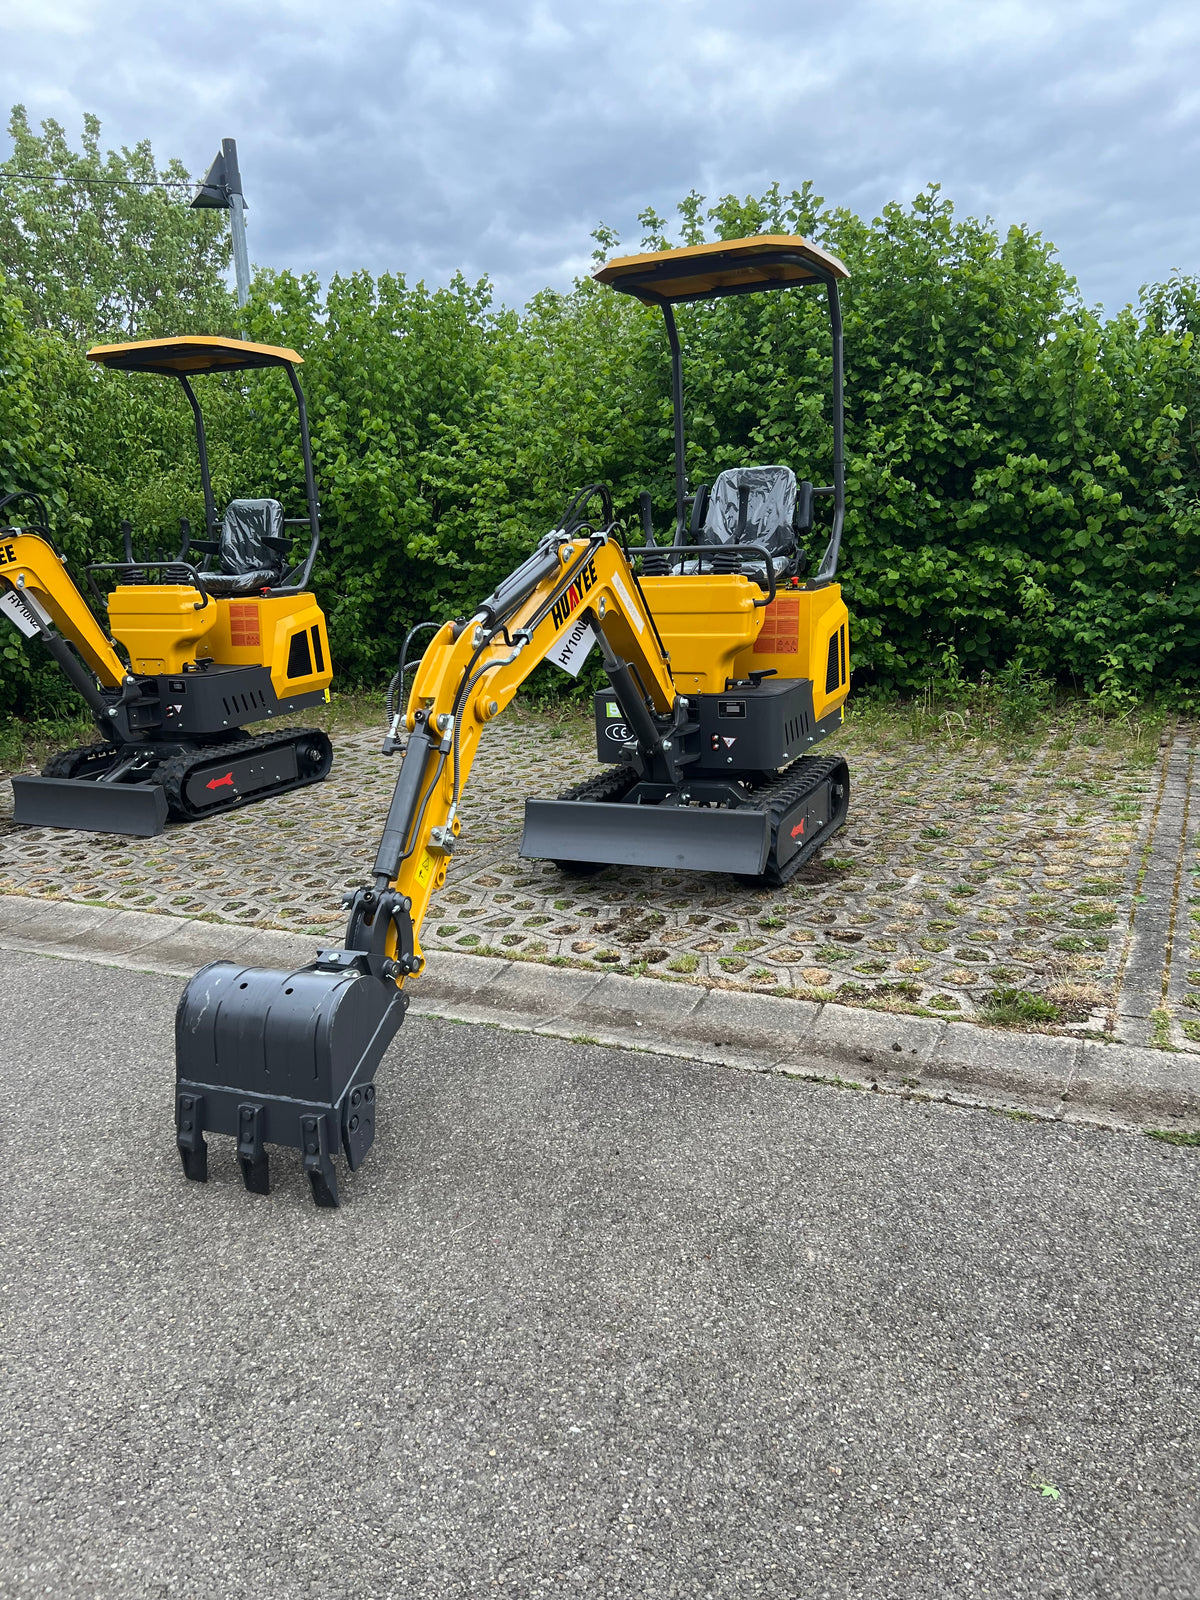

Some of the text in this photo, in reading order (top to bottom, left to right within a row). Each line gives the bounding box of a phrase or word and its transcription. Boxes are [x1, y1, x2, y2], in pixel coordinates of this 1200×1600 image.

[551, 558, 598, 631] HUAYEE
[558, 618, 590, 665] HY10N
[612, 726, 628, 738] CE
